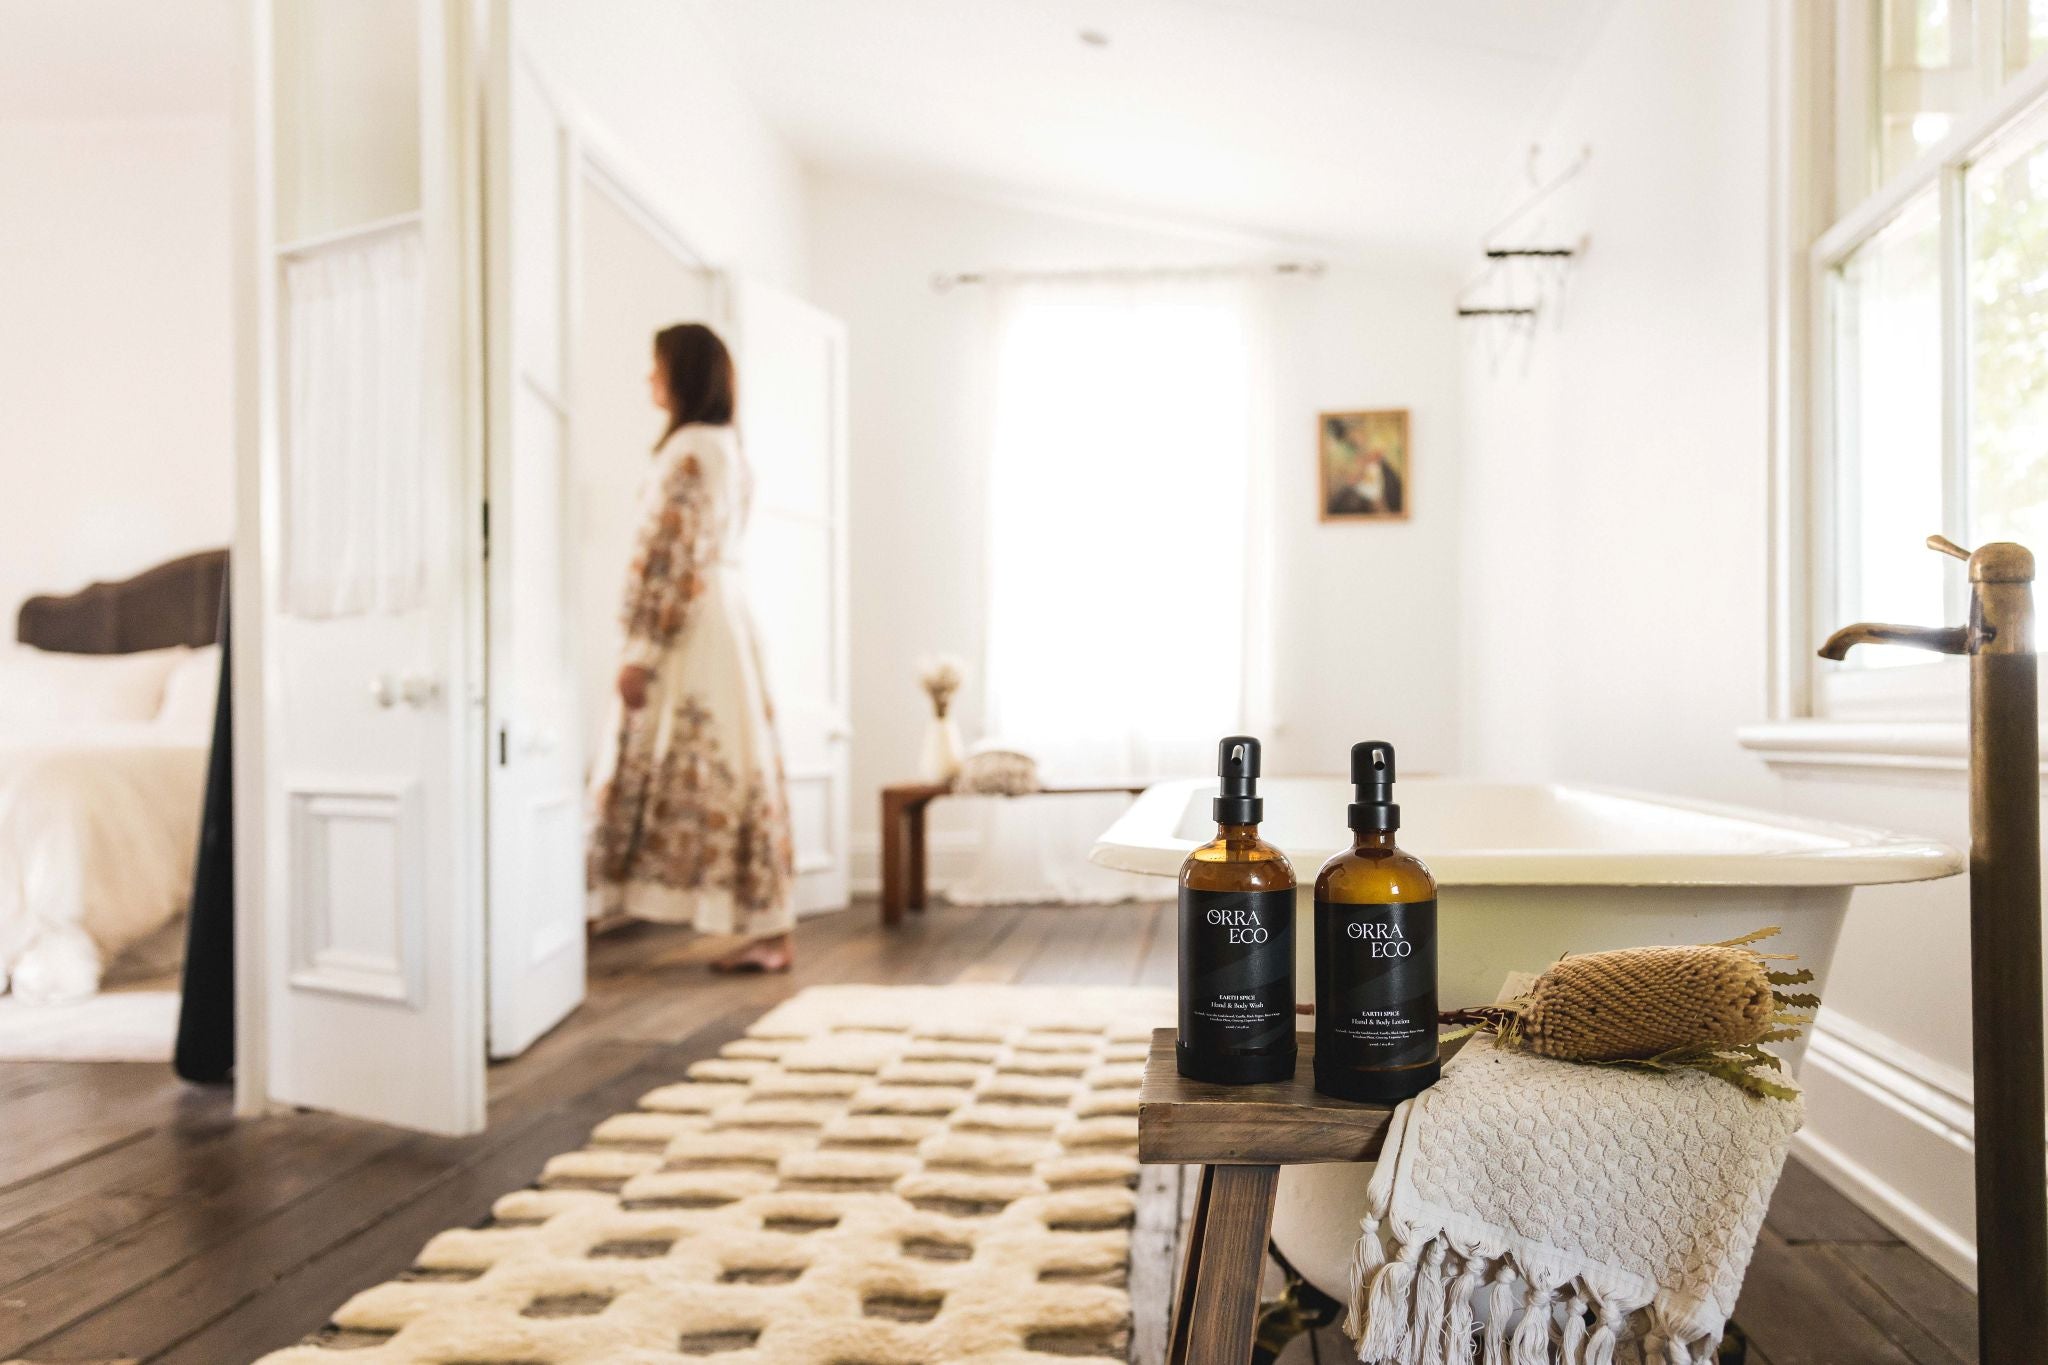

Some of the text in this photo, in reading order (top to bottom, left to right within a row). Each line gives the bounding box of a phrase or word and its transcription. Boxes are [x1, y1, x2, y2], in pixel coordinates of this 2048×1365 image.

[1207, 909, 1261, 926] ORRA
[1229, 927, 1268, 944] ECO
[1347, 922, 1404, 939] ORRA
[1371, 941, 1412, 958] ECO
[1211, 1001, 1226, 1009] Hand
[1233, 1001, 1248, 1010] Body
[1249, 1001, 1264, 1009] Wash
[1376, 1018, 1391, 1027] Body
